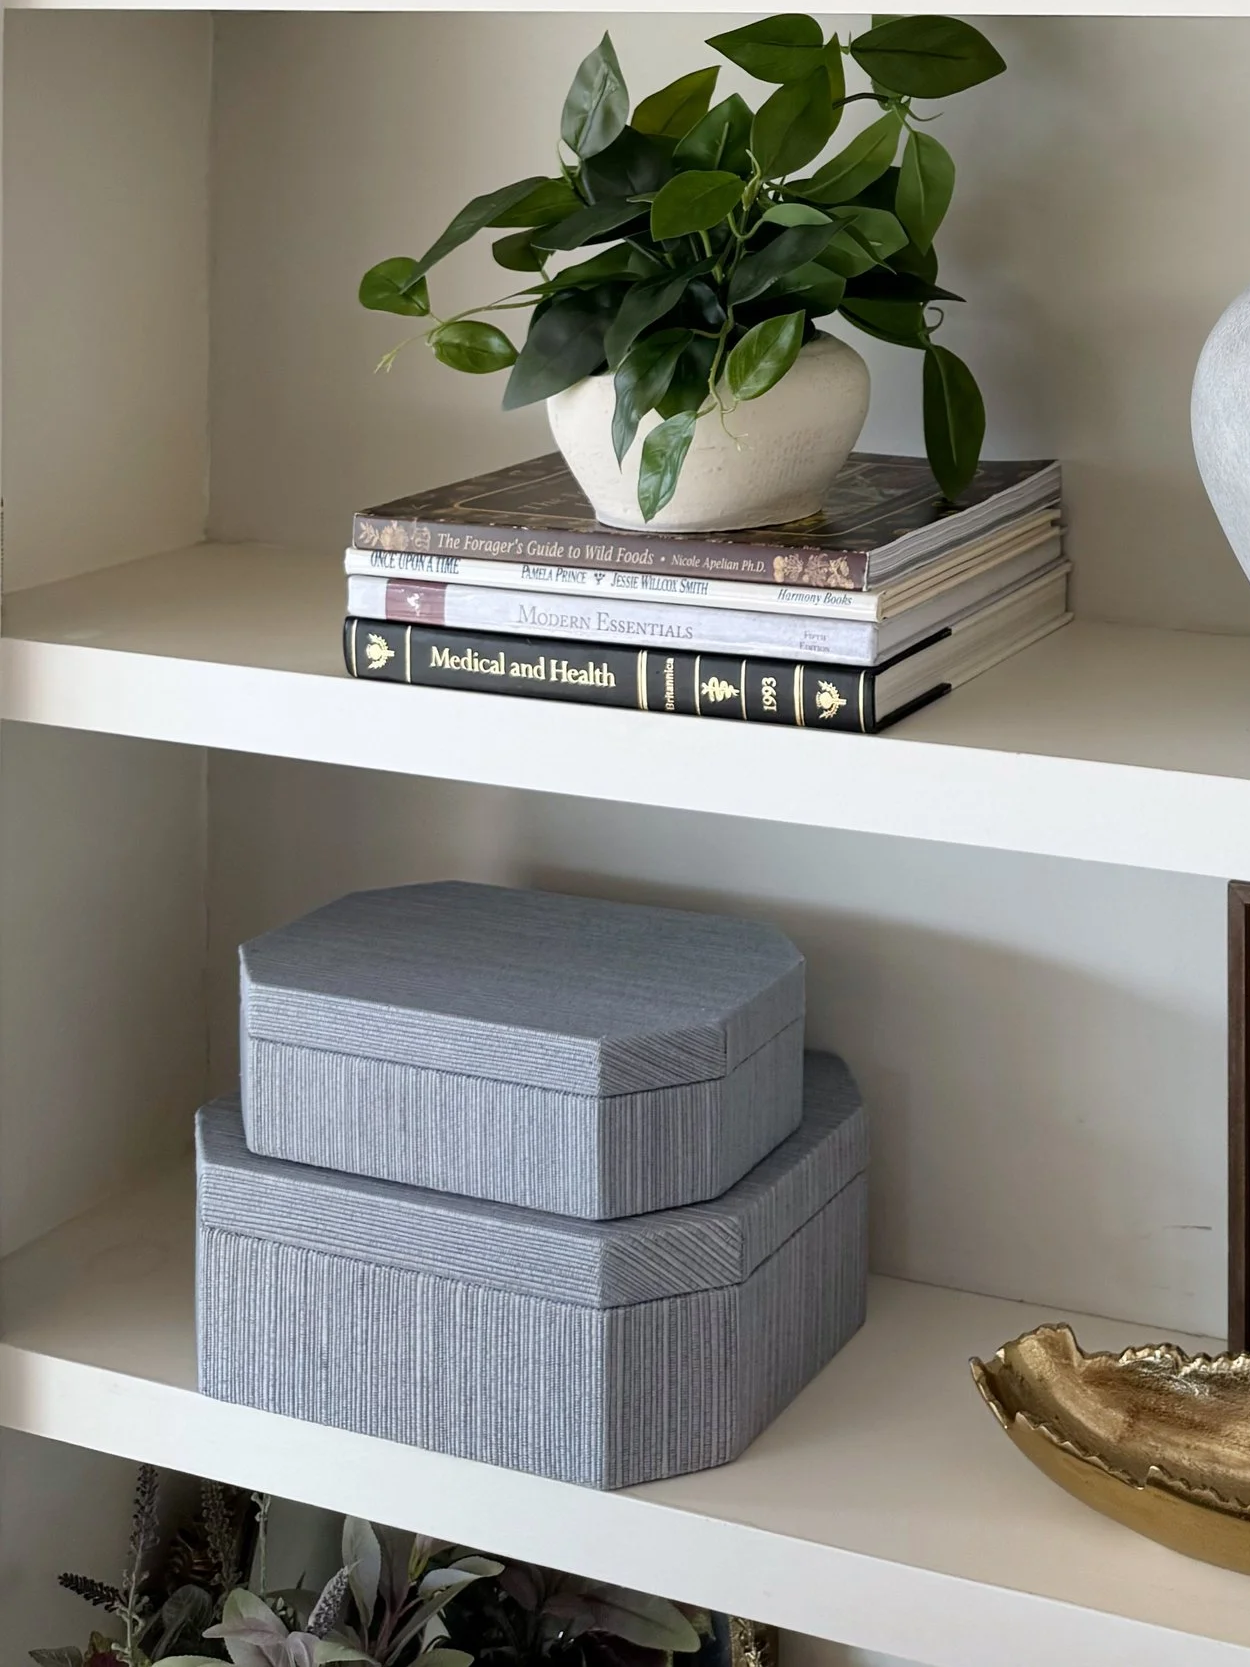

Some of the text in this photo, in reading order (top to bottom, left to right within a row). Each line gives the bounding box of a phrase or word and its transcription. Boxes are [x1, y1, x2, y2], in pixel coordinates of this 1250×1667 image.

[370, 550, 396, 568] ONCE
[399, 552, 425, 571] UPON
[436, 555, 461, 574] TIME
[437, 532, 767, 573] The Forager's Guide to Wild Foods Nicole Apelian Ph.D.
[521, 564, 709, 595] PAMELA PRINCE JESSIE WILLCOX SMITH
[777, 588, 853, 605] Harmony Books
[518, 604, 693, 639] MODERN ESSENTIALS
[429, 645, 616, 687] Medical and Health
[664, 657, 675, 712] Britannica
[761, 677, 777, 713] 1993
